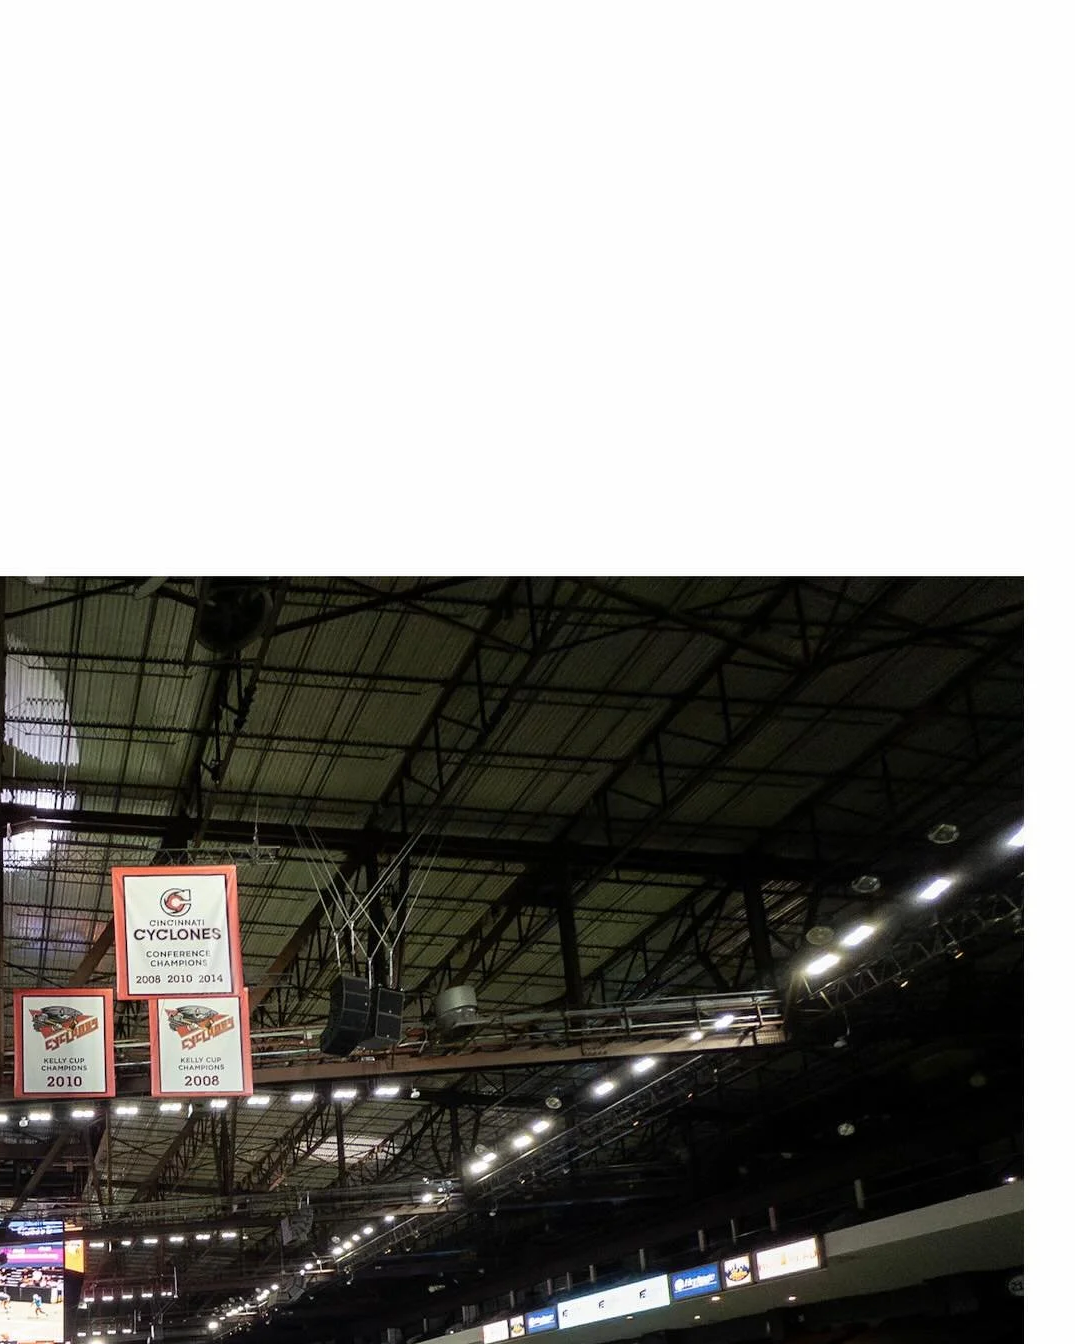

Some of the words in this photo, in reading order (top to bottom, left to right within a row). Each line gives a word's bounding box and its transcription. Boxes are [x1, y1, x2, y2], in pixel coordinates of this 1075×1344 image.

[149, 919, 205, 927] CINCINNATI
[133, 928, 221, 941] CYCLONES
[146, 949, 211, 958] CONFERENCE
[150, 959, 208, 967] CHAMPIONS
[136, 975, 161, 985] 2008
[167, 974, 193, 984] 2010
[198, 974, 223, 983] 2014
[47, 1076, 82, 1087] 2010
[184, 1075, 220, 1087] 2008
